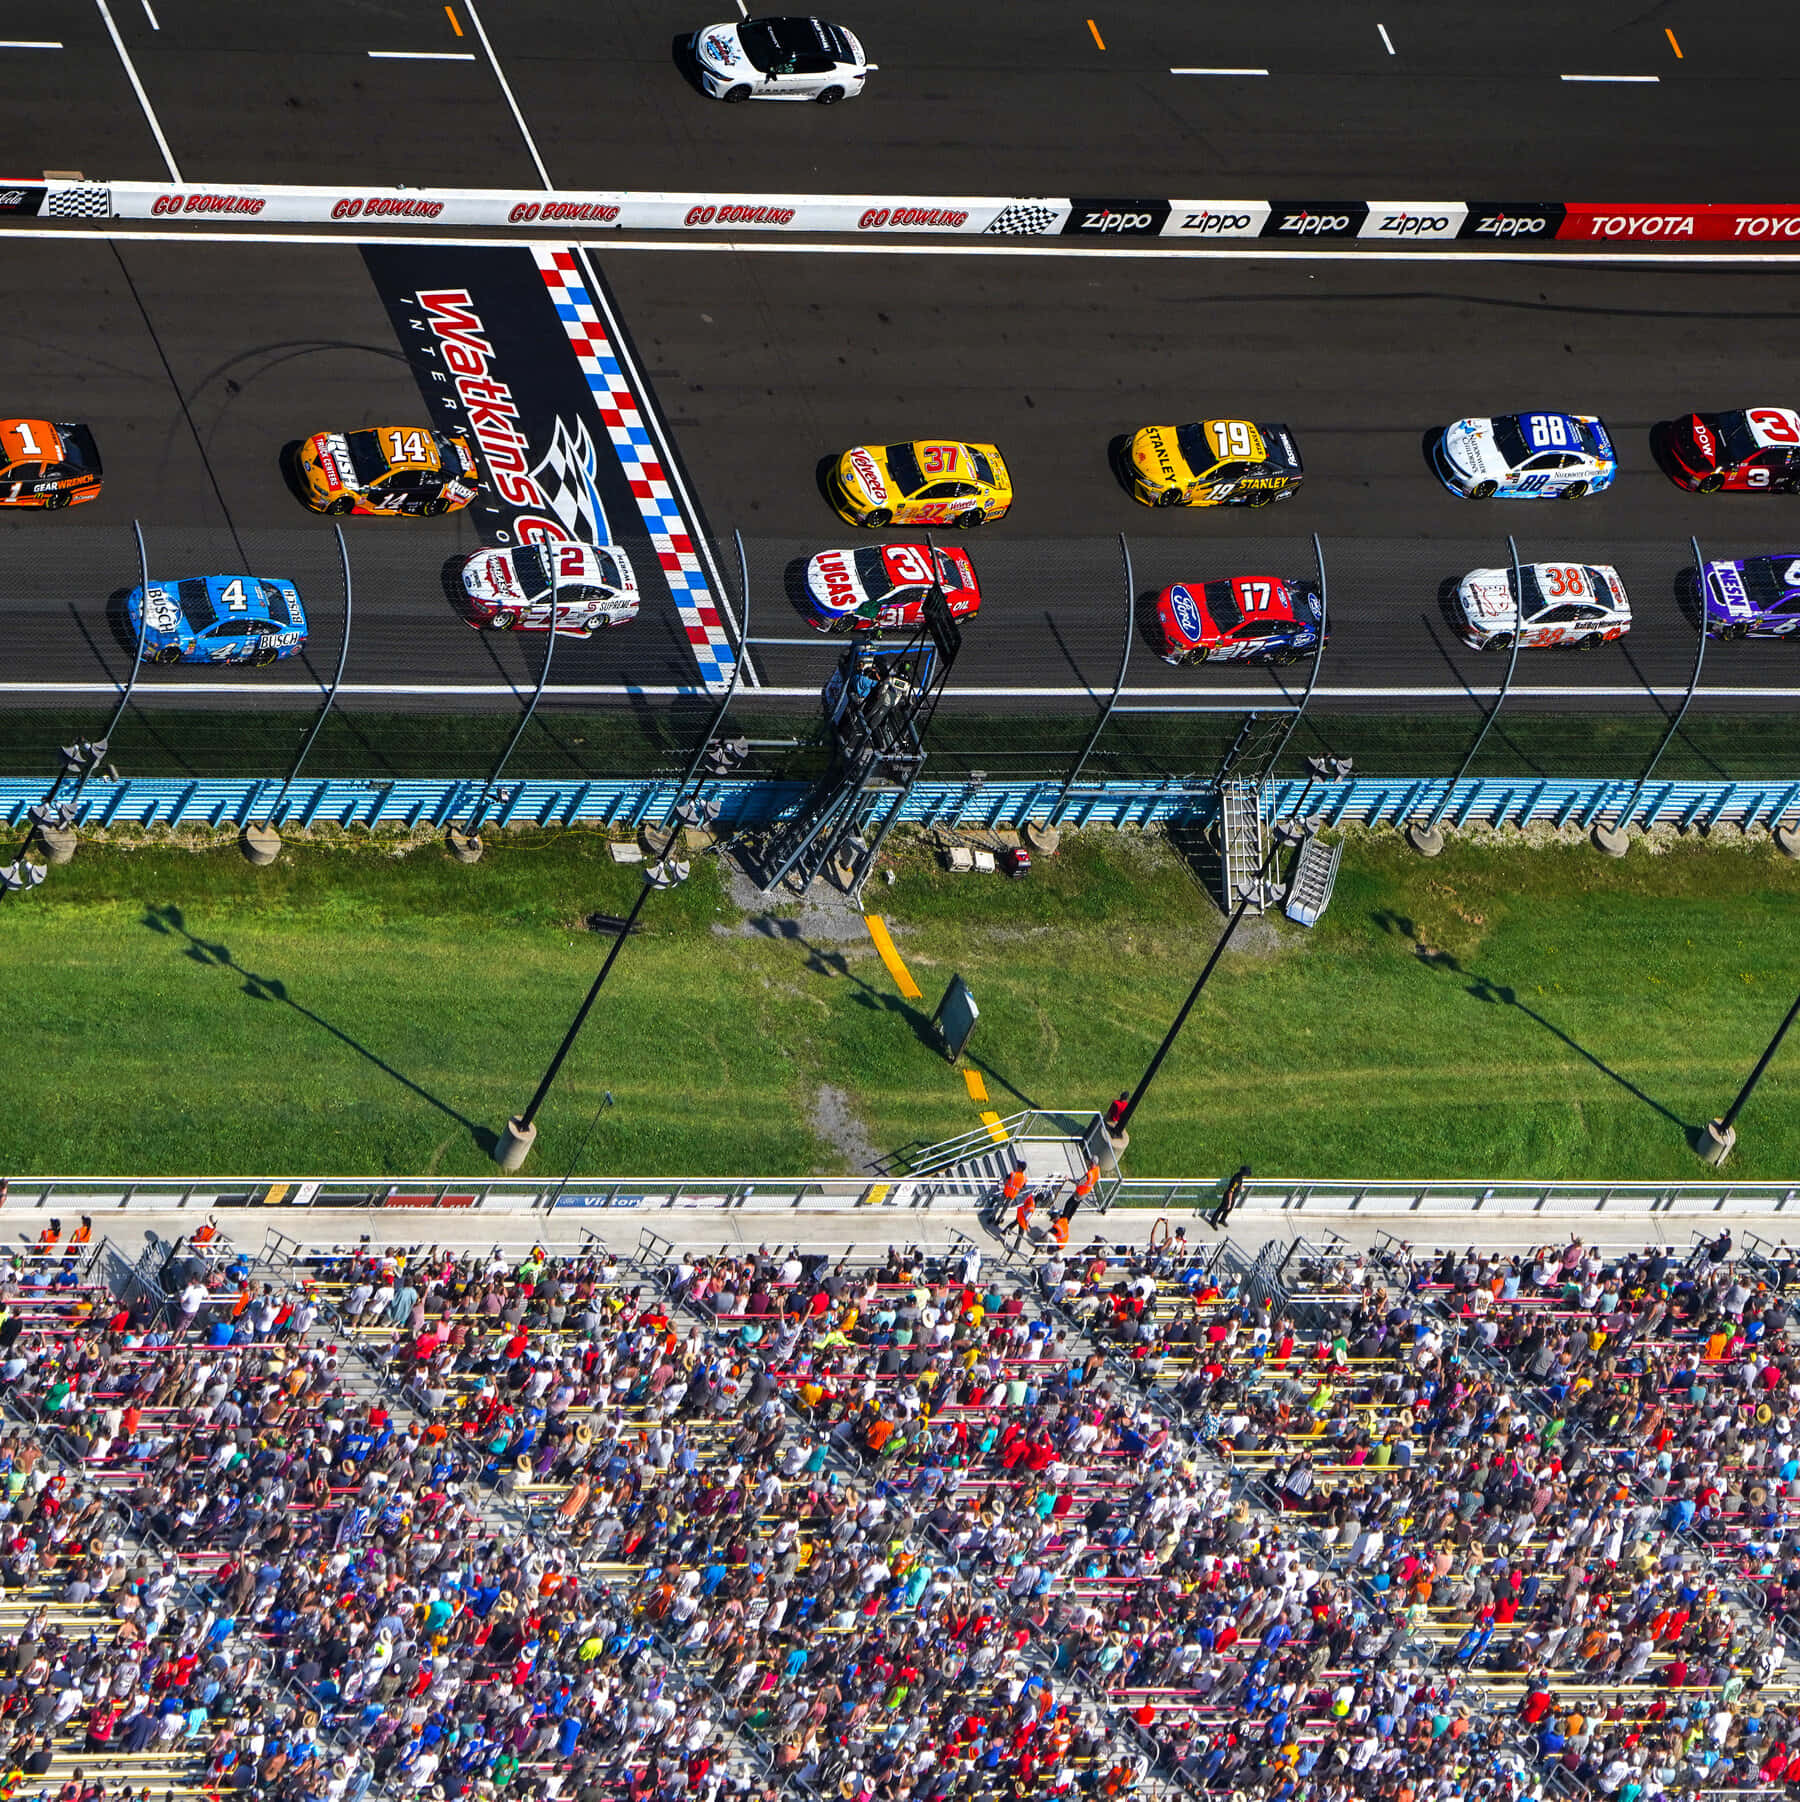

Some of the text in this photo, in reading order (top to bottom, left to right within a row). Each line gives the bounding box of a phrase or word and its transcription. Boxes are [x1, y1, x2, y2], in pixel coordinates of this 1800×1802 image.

[152, 195, 265, 215] GO BOWLING
[331, 198, 444, 219] GO BOWLING
[509, 202, 620, 223] GO BOWLING
[685, 205, 795, 226] GO BOWLING
[858, 208, 970, 229] GO BOWLING
[1591, 216, 1694, 236] TOYOTA
[415, 289, 546, 510] Watkins
[15, 423, 42, 454] 1
[1530, 416, 1567, 447] 88
[1750, 410, 1800, 443] 3
[389, 432, 427, 463] 14
[1213, 422, 1252, 458] 19
[1694, 425, 1714, 457] DOW
[316, 438, 338, 486] TRUCK CENTERS
[924, 446, 960, 473] 37
[1146, 427, 1177, 483] STANLEY
[850, 450, 888, 500] Velveeta
[1239, 477, 1289, 489] STANLEY
[1517, 474, 1551, 491] 88
[1747, 468, 1770, 487] 3
[4, 482, 23, 503] 1
[375, 493, 408, 510] 14
[1204, 483, 1236, 501] 19
[915, 503, 949, 520] 37
[561, 547, 584, 576] 2
[886, 547, 935, 581] 31
[816, 552, 857, 606] LUCAS
[1547, 567, 1584, 597] 38
[1717, 568, 1747, 606] NESN
[221, 579, 248, 611] 4
[284, 589, 304, 624] BUSCH
[953, 601, 969, 612] OIL
[1240, 582, 1272, 612] 17
[148, 589, 174, 633] BUSCH
[879, 607, 905, 626] 31
[261, 633, 298, 648] BUSCH
[1530, 627, 1567, 644] 38
[210, 643, 236, 660] 4
[1229, 640, 1266, 658] 17
[584, 1196, 642, 1209] Vitory
